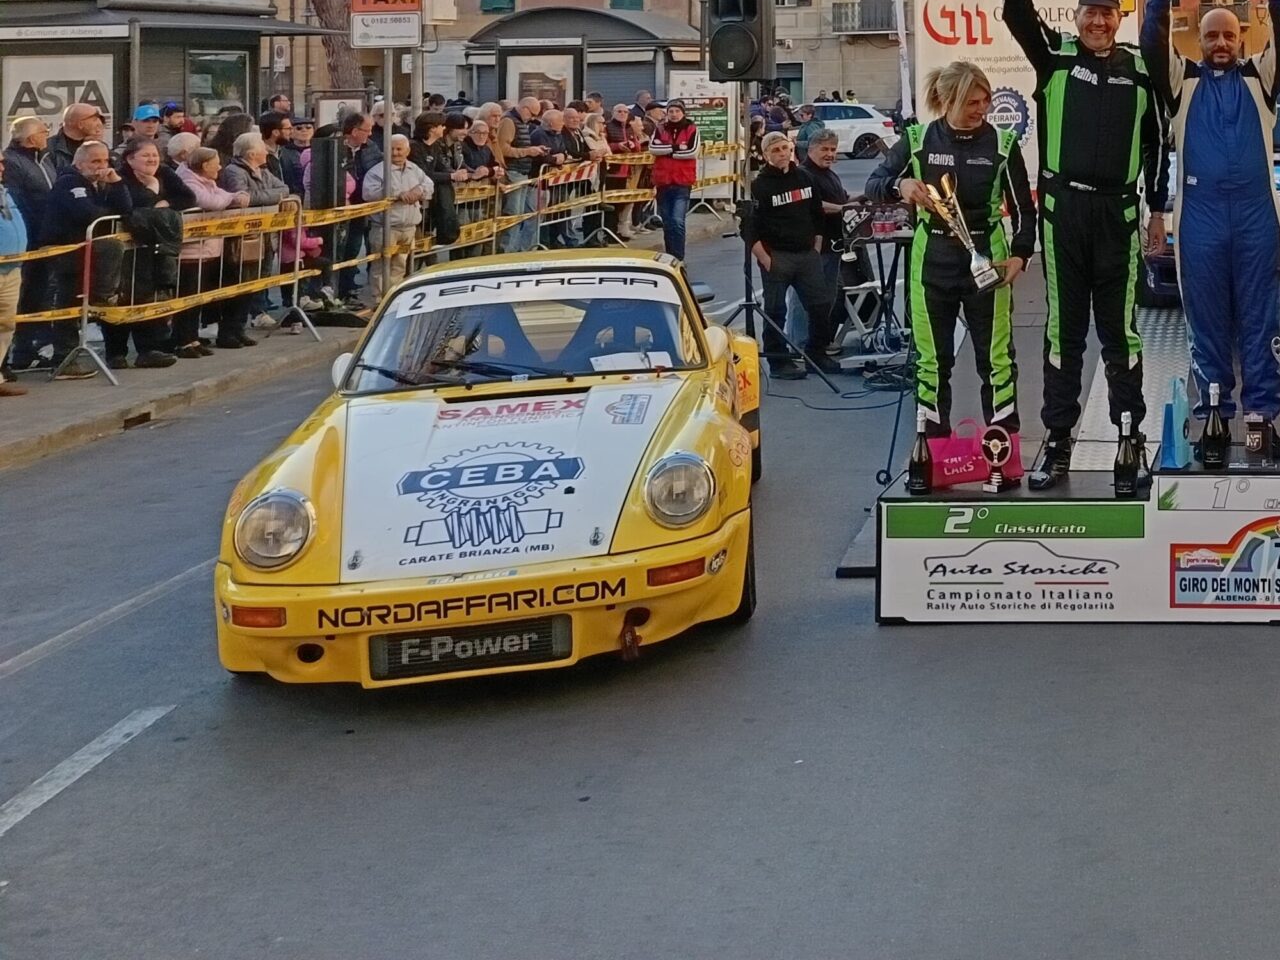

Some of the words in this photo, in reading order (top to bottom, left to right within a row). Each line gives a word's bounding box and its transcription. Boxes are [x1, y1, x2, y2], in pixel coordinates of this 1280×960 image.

[993, 6, 1076, 24] GOLFO
[7, 79, 110, 116] ASTA
[988, 113, 1021, 123] PEIRANO
[408, 291, 427, 311] 2
[437, 398, 586, 421] SAMEX
[418, 461, 561, 490] CEBA
[431, 481, 544, 509] INGRANAGGI
[994, 523, 1086, 535] Classificato
[398, 551, 455, 567] CARATE
[457, 545, 520, 559] BRIANZA
[523, 543, 556, 555] (MB)
[928, 562, 994, 578] Auto
[1003, 561, 1110, 577] Storiche
[1179, 576, 1208, 594] GIRO
[1211, 577, 1231, 593] DEI
[1233, 577, 1272, 594] MONTI
[317, 577, 627, 630] NORDAFFARI.COM
[926, 589, 1033, 603] Campionato
[1041, 589, 1114, 601] Italiano
[1214, 594, 1258, 602] ALBENGA
[926, 601, 956, 611] Rally
[960, 602, 986, 610] Auto
[989, 601, 1037, 610] Storiche
[1040, 601, 1051, 610] di
[1055, 601, 1115, 611] Regolarità
[400, 629, 540, 666] F-Power
